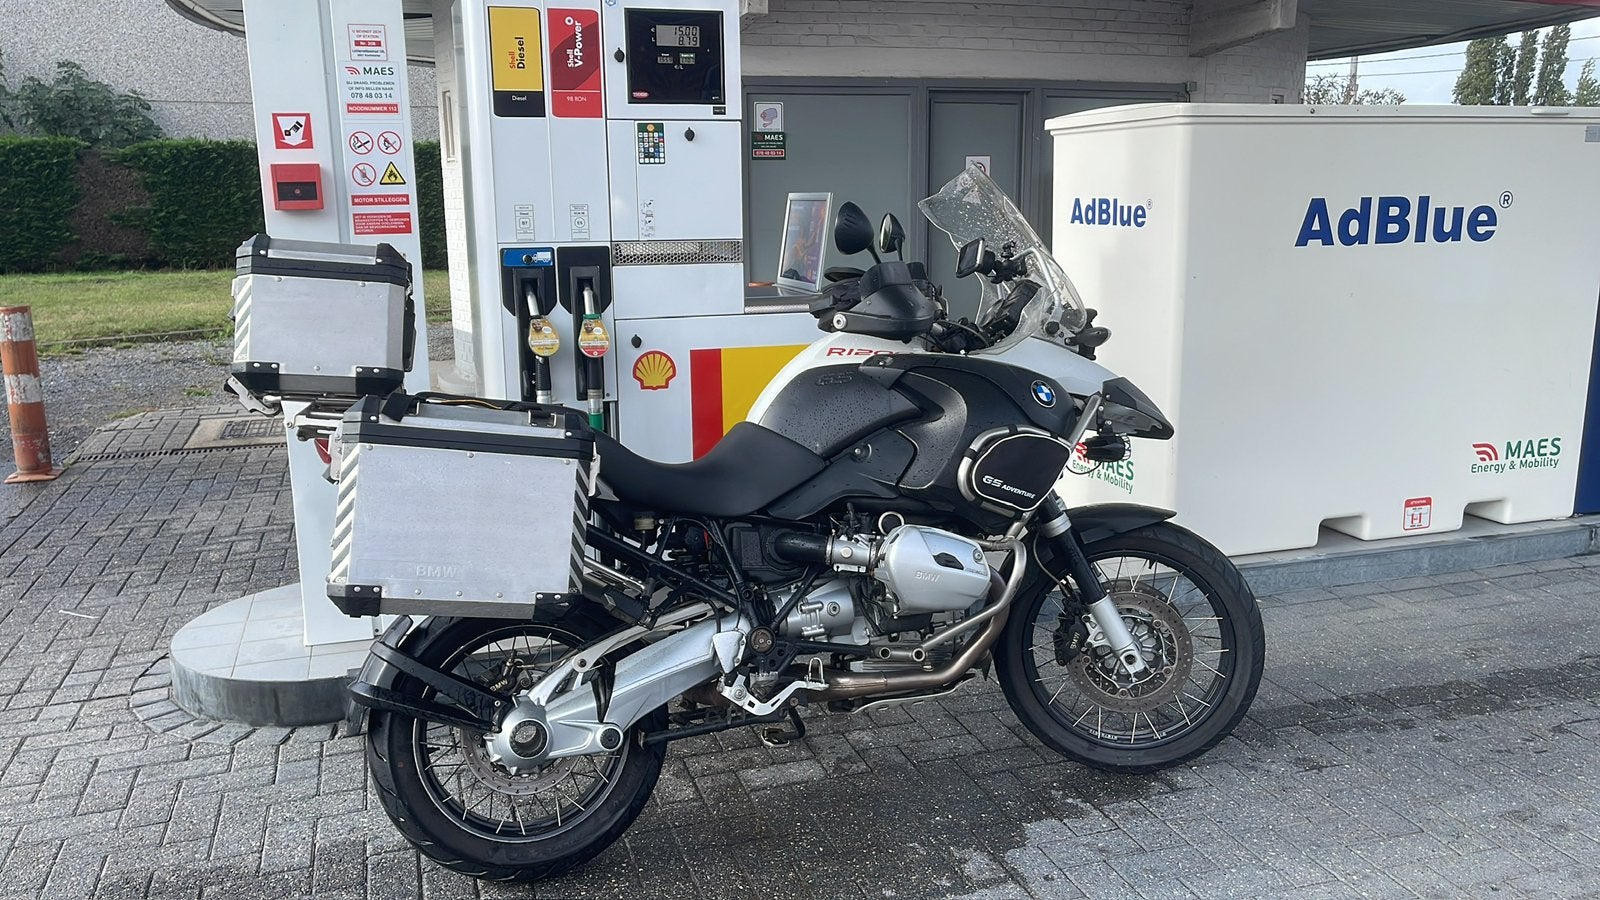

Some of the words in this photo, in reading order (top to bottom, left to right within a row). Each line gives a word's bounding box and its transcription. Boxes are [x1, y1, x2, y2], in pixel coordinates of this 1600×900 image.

[674, 26, 698, 36] 15.00
[574, 20, 583, 68] V-Power
[678, 36, 698, 46] 8.79
[514, 36, 526, 70] Diesel
[363, 67, 394, 75] MAES
[1505, 437, 1561, 459] MAES
[1471, 464, 1506, 474] Energy
[1509, 461, 1516, 469] &
[1520, 457, 1559, 469] Mobility
[982, 475, 1003, 487] GS
[1001, 484, 1036, 499] ADVENTURE
[1097, 469, 1103, 478] &
[1104, 472, 1133, 494] Mobility
[416, 565, 457, 578] BMW
[490, 679, 507, 691] BMW
